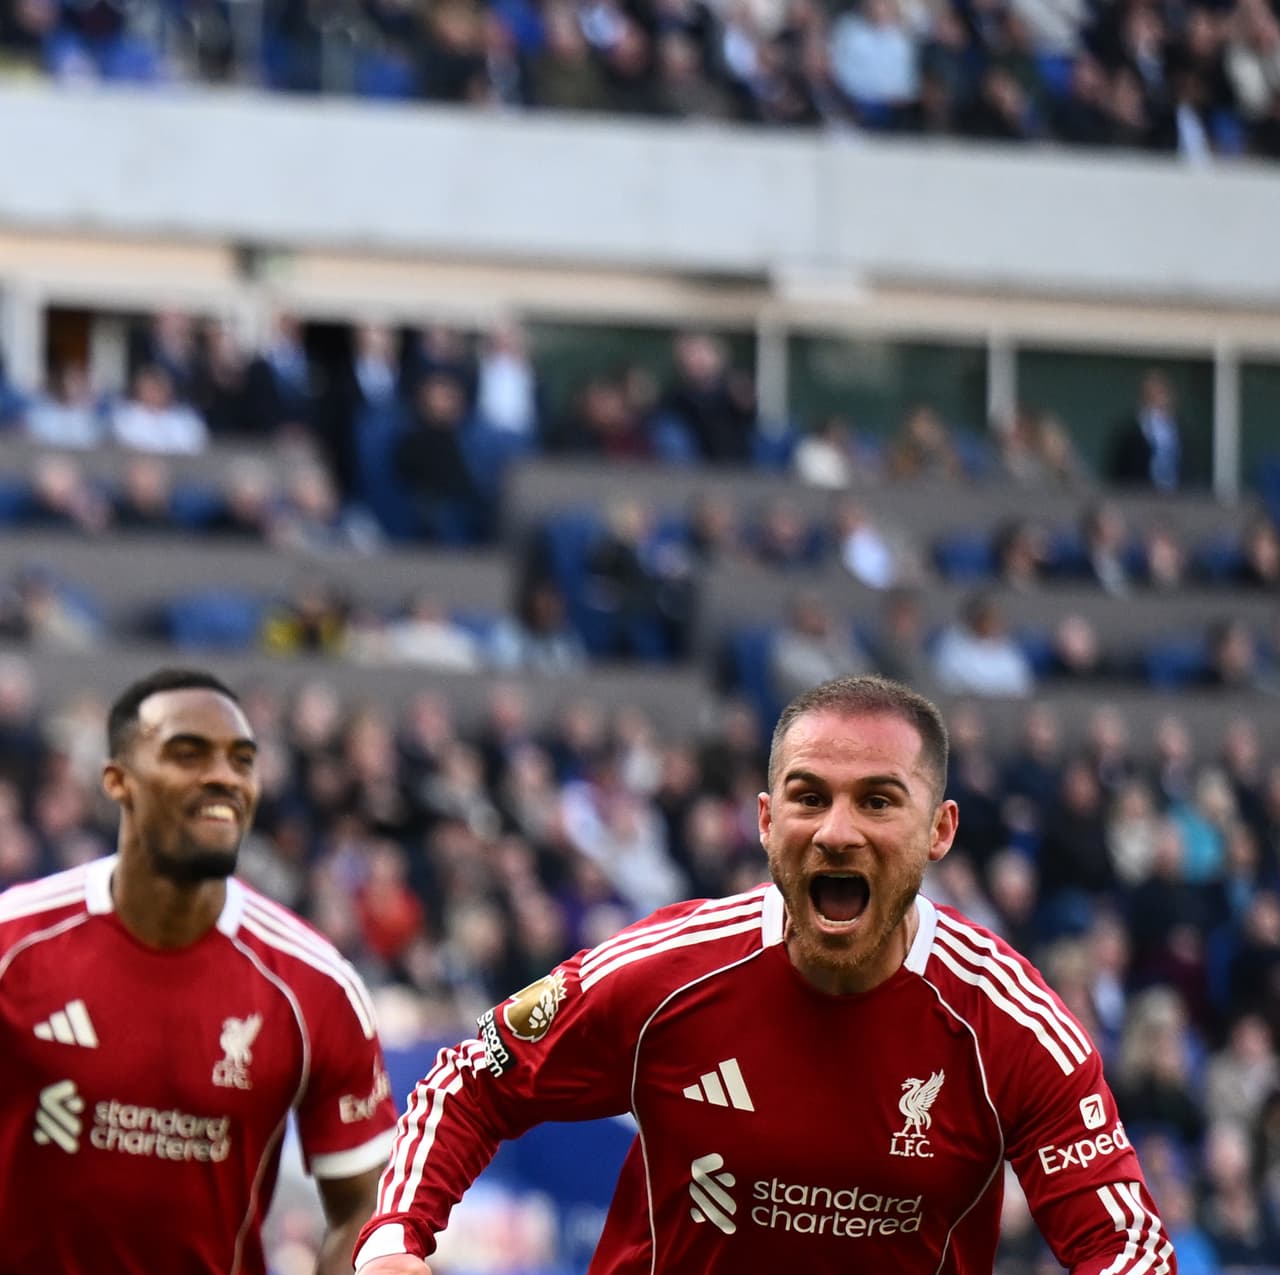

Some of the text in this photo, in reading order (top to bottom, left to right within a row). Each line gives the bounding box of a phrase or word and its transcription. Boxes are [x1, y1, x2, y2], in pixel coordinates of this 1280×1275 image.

[487, 1021, 510, 1065] room
[94, 1099, 231, 1141] standard
[90, 1126, 231, 1163] chartered
[889, 1138, 934, 1158] L.F.C.
[753, 1178, 922, 1214] standard
[751, 1204, 922, 1238] chartered
